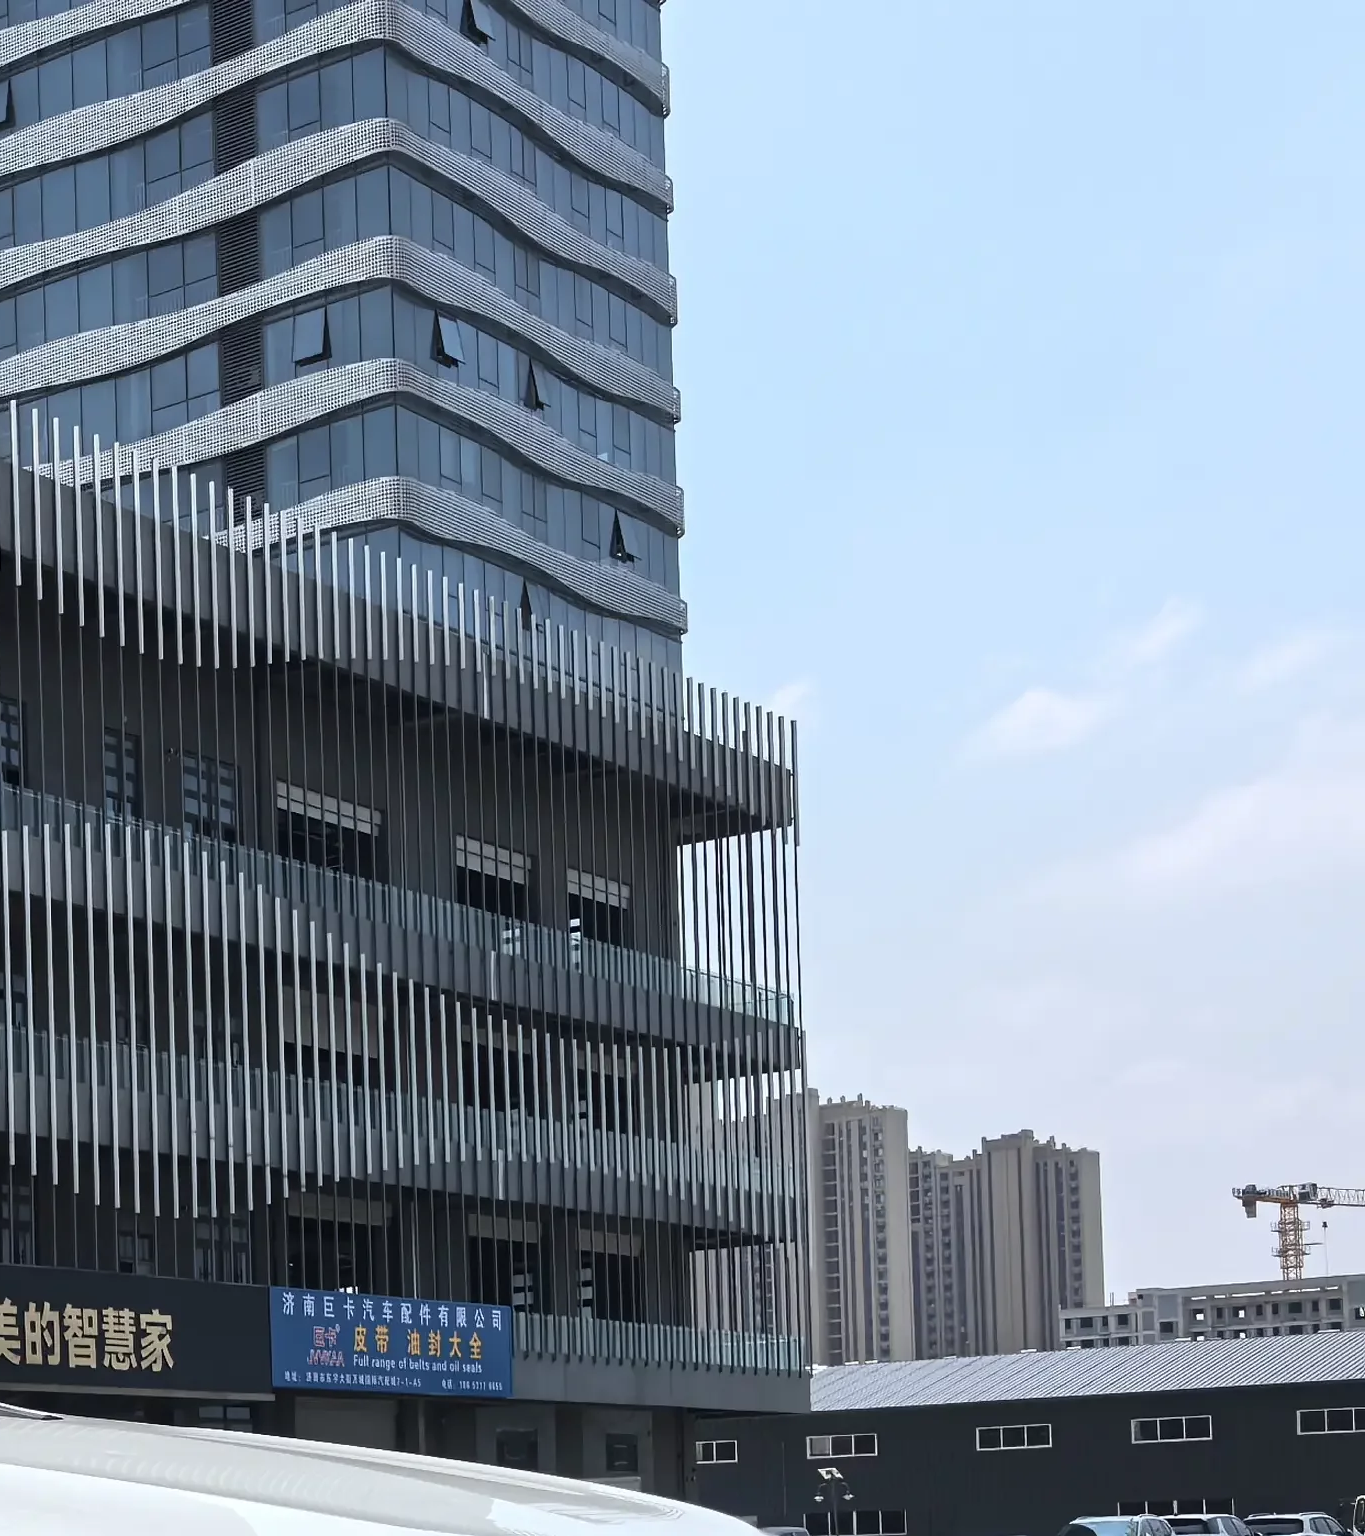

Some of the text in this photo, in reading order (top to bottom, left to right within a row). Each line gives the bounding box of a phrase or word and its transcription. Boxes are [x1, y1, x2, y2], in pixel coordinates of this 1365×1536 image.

[282, 1291, 502, 1332] 济南巨卡汽车配件有限公司
[353, 1322, 482, 1360] 皮带 油封大全
[353, 1354, 370, 1367] Full
[372, 1358, 396, 1371] range
[398, 1358, 407, 1369] of
[409, 1358, 430, 1371] belts
[431, 1361, 447, 1372] and
[449, 1361, 460, 1372] oil
[462, 1361, 483, 1374] seals
